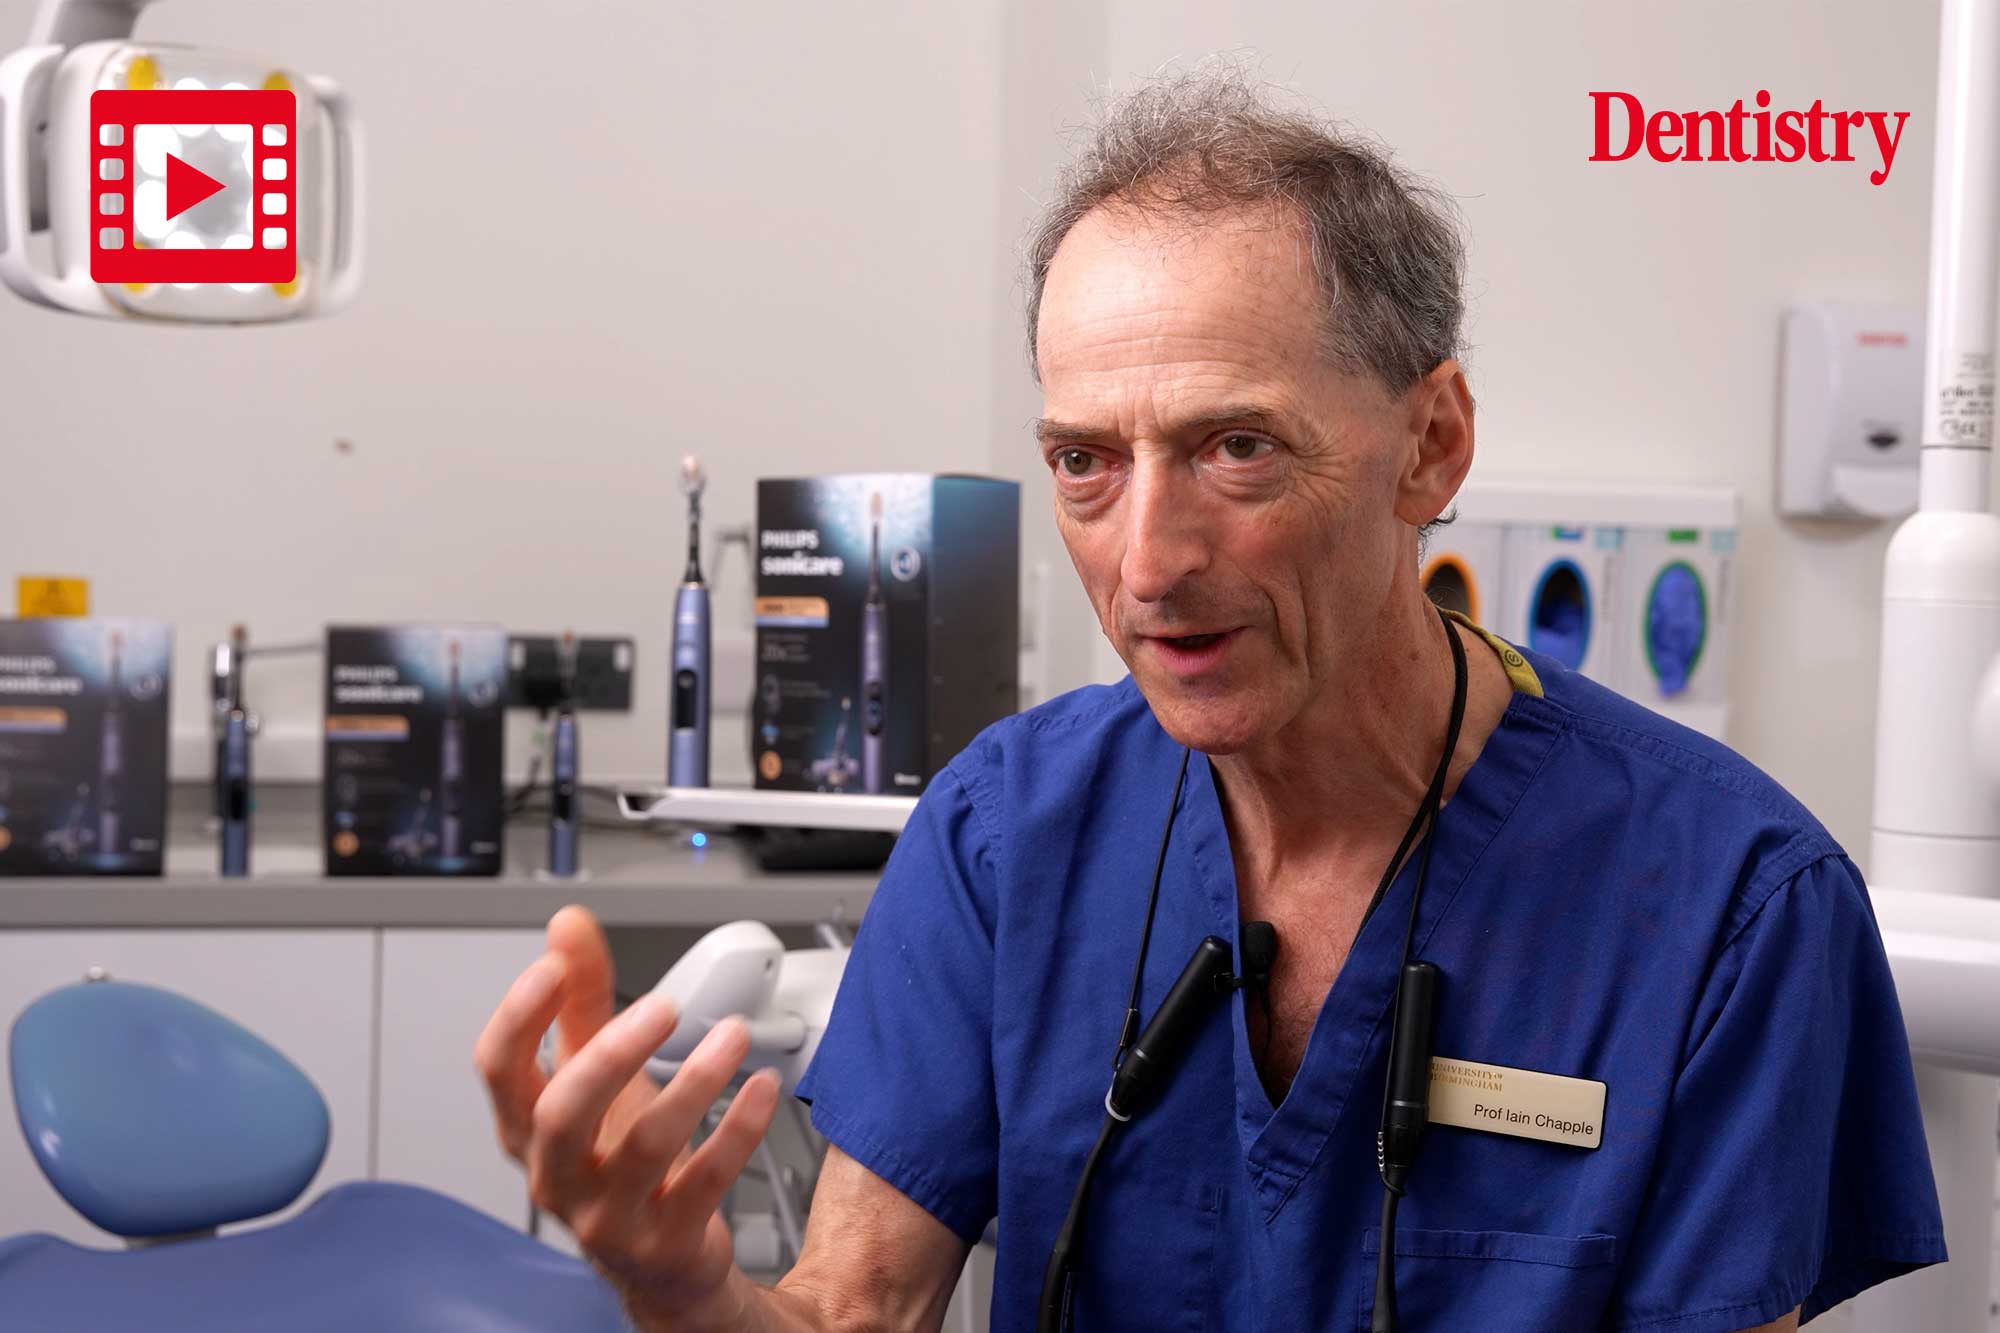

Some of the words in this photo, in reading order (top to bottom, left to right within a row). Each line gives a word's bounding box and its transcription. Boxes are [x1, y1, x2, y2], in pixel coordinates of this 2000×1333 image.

[761, 529, 819, 550] PHILIPS
[761, 550, 843, 576] sonicare
[1474, 1104, 1503, 1120] Prof
[1505, 1109, 1530, 1125] Iain
[1535, 1114, 1594, 1135] Chapple
